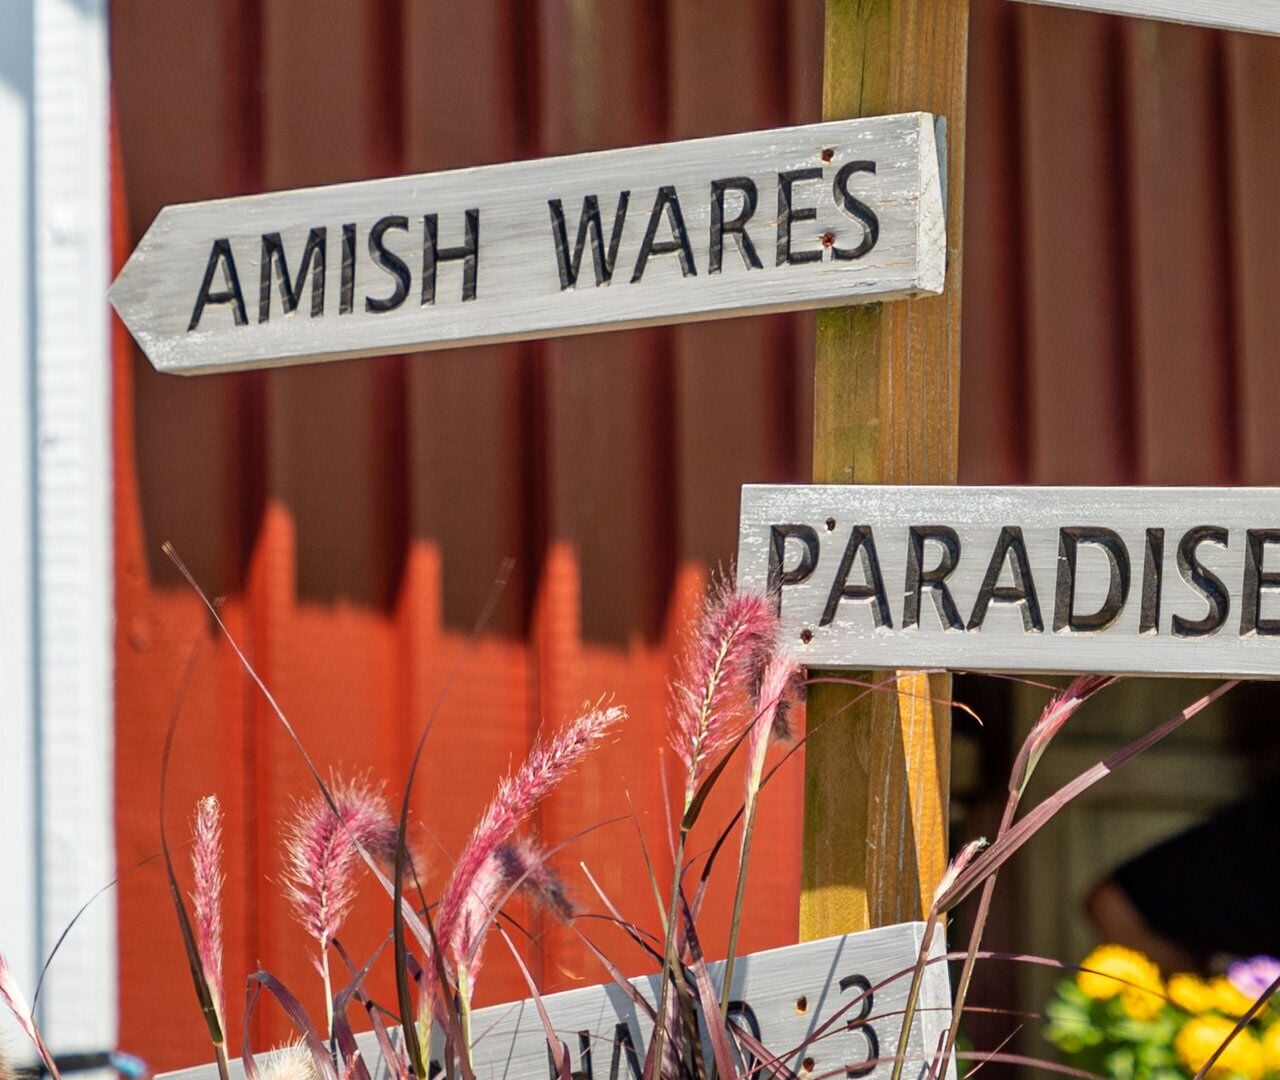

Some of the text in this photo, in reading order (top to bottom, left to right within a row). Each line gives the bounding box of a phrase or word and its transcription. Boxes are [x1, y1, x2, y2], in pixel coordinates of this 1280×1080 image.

[186, 159, 880, 333] AMISH WARES
[838, 972, 881, 1080] 3
